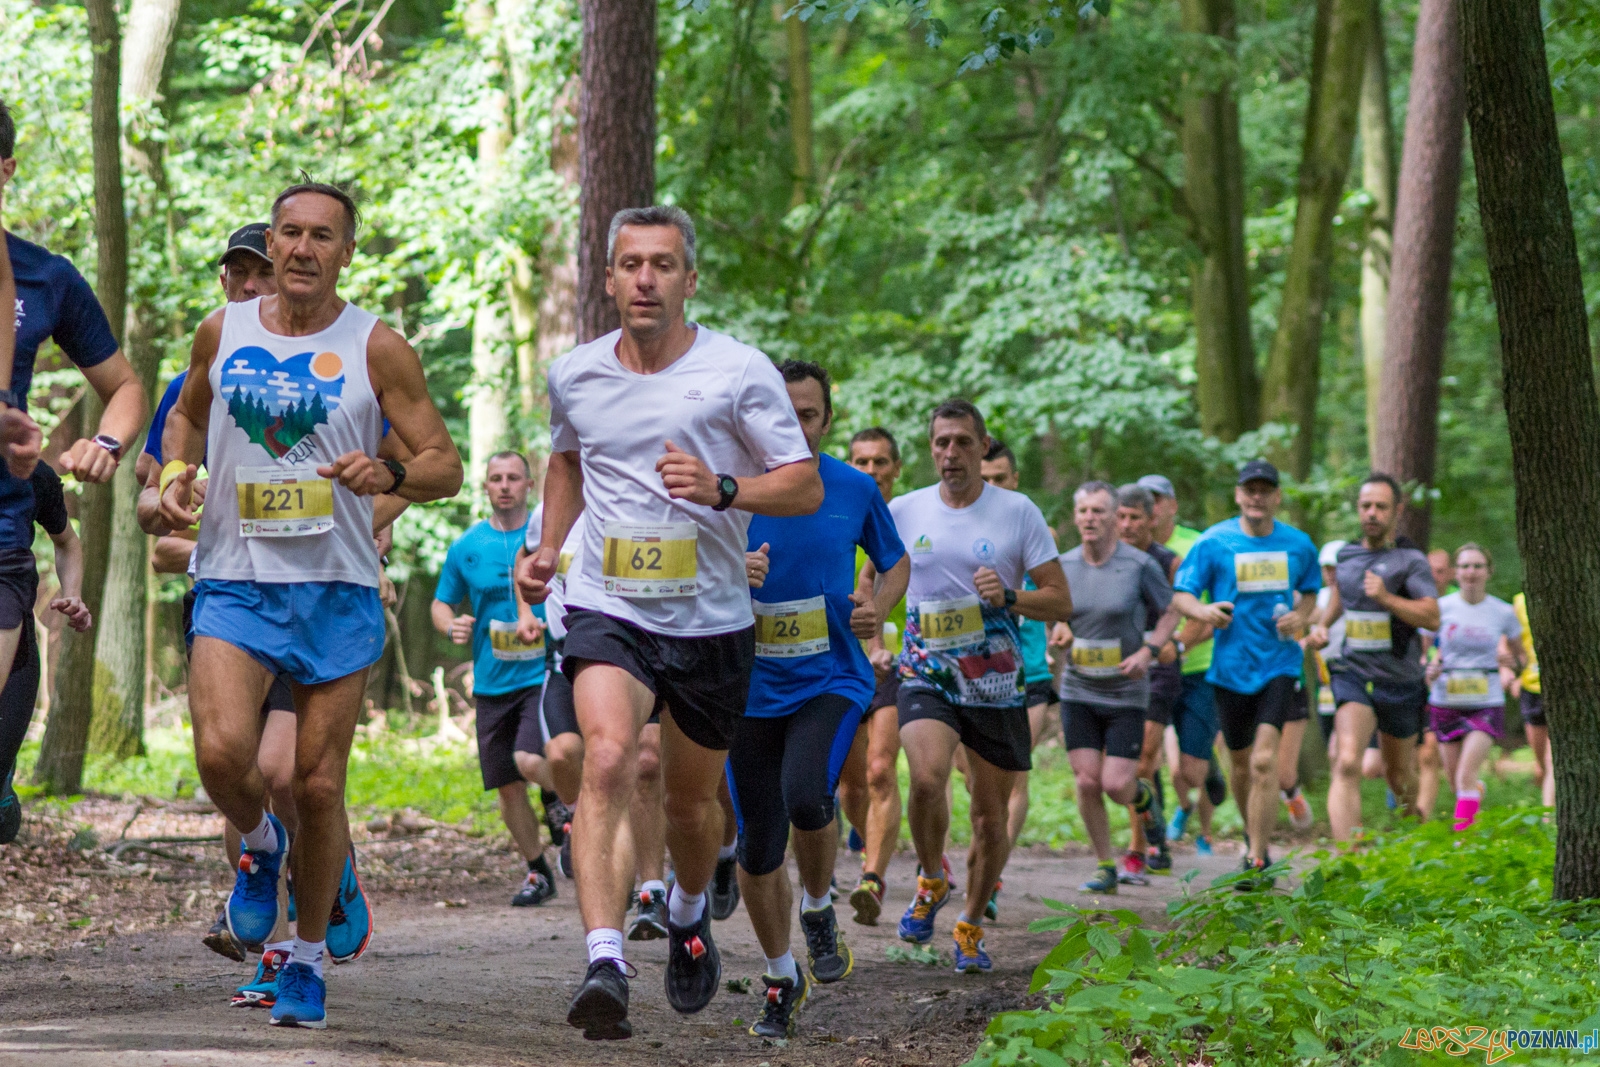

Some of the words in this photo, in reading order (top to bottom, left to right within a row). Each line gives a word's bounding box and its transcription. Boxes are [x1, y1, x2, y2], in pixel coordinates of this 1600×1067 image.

[285, 435, 317, 466] RUN
[261, 488, 304, 512] 221
[631, 547, 662, 570] 62
[775, 619, 801, 637] 26
[934, 614, 964, 632] 129
